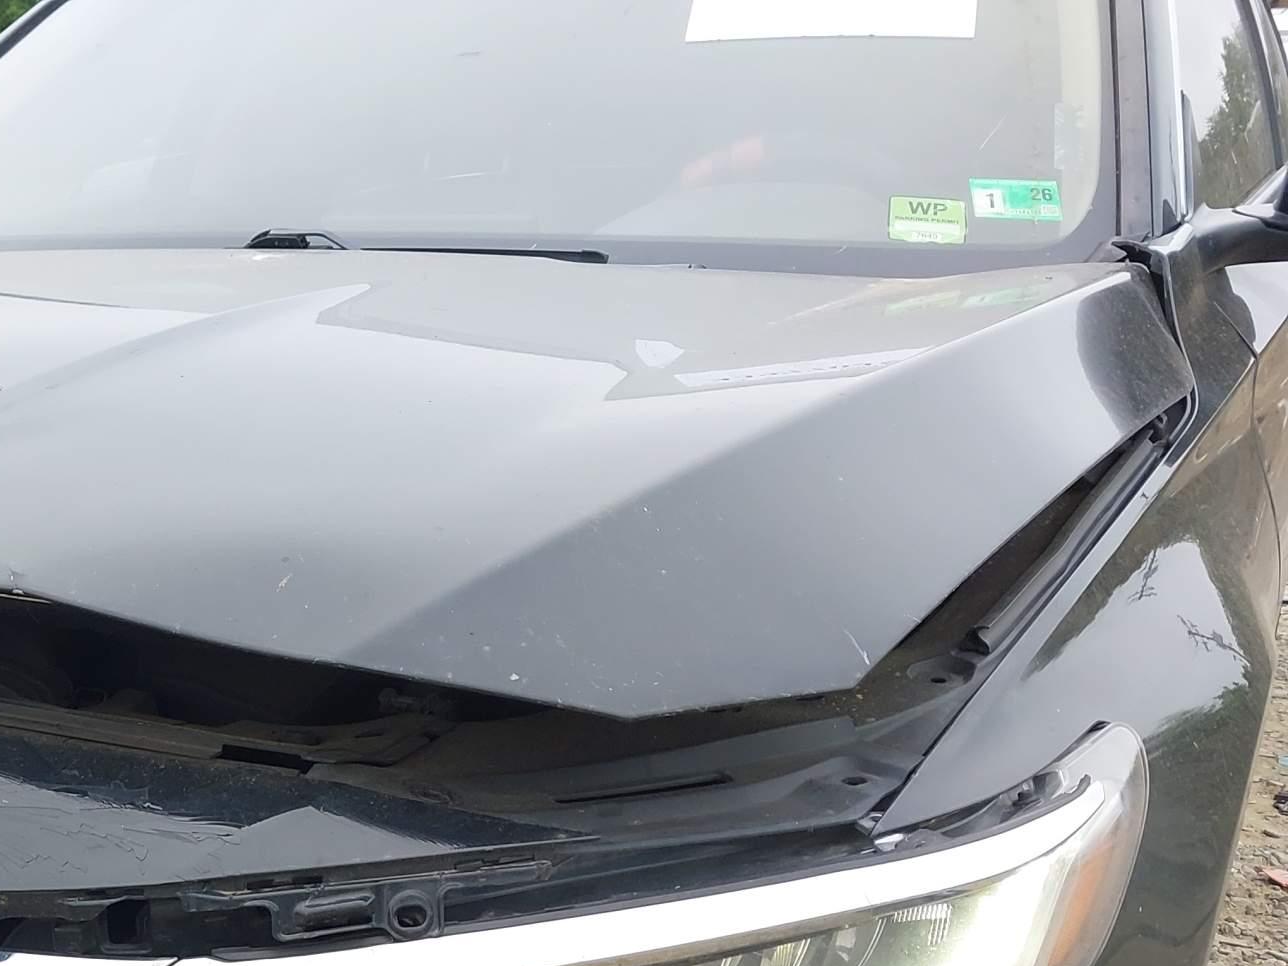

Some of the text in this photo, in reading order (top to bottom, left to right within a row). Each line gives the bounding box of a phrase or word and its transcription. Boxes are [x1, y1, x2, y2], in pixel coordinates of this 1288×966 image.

[985, 188, 1052, 208] 1 26
[908, 201, 948, 216] WP
